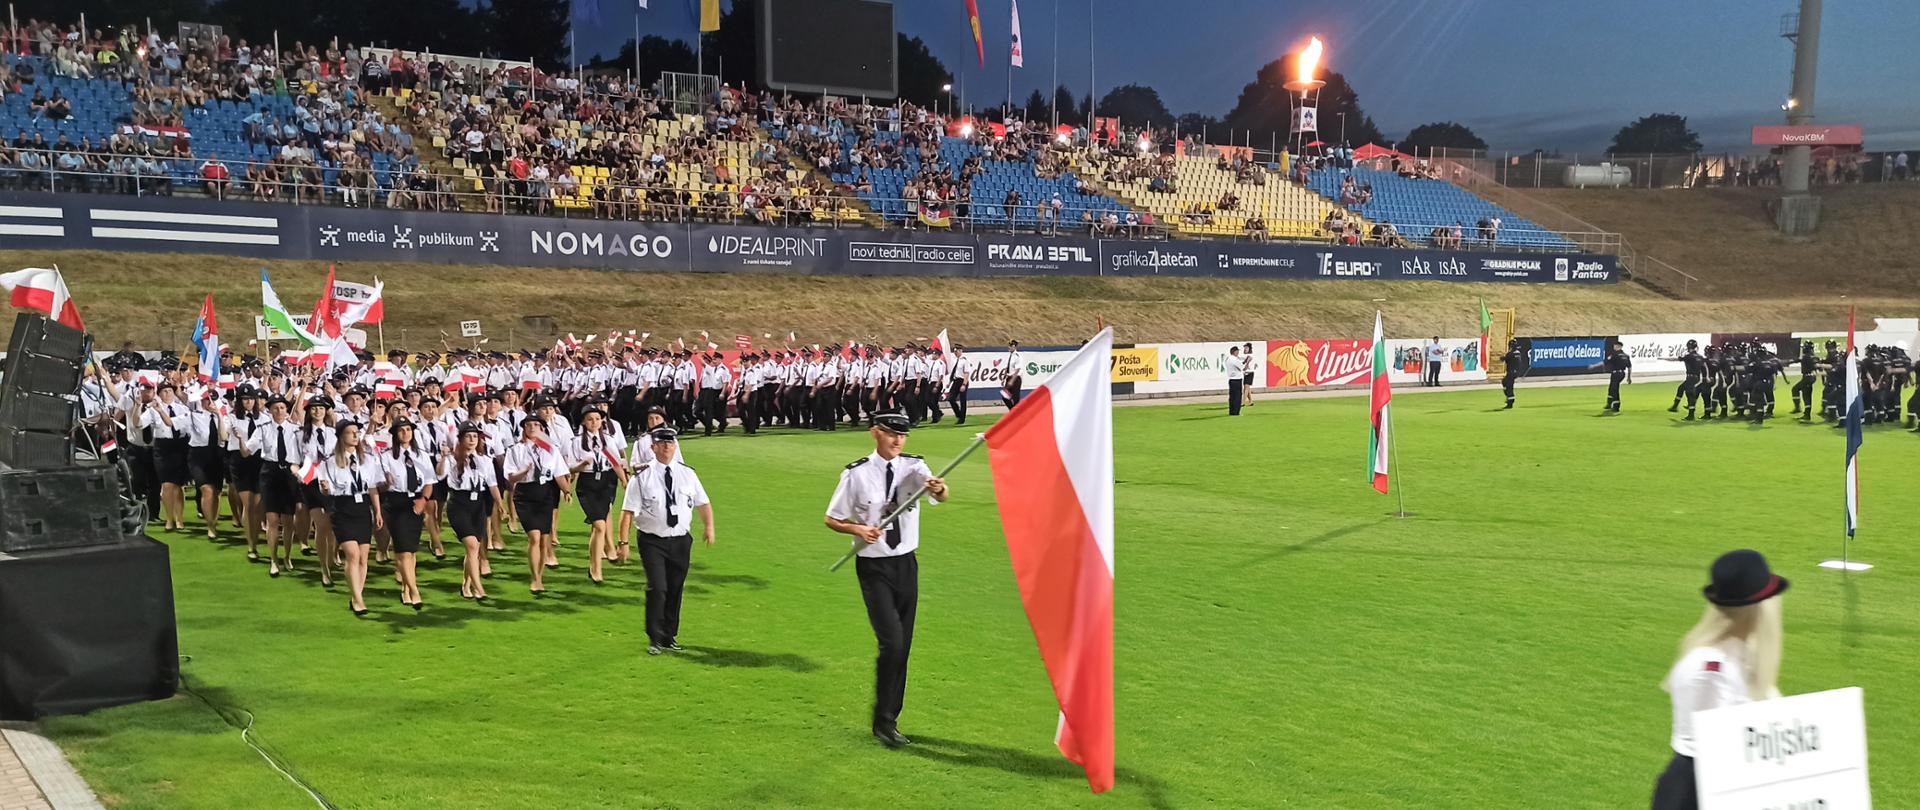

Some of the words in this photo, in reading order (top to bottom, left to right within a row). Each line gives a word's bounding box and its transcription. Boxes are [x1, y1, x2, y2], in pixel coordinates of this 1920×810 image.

[347, 230, 386, 244] media
[419, 233, 474, 247] publikum
[531, 230, 672, 258] NOMAGO
[720, 235, 827, 257] IDEALPRINT
[852, 246, 876, 258] novi
[879, 247, 911, 259] tednik
[988, 244, 1043, 260] PRANA
[918, 248, 945, 260] radio
[947, 249, 971, 261] celje
[1401, 255, 1432, 275] ISAR
[1439, 256, 1467, 276] ISAR
[1576, 261, 1604, 271] Radio
[1571, 270, 1609, 281] Fantasy
[1119, 354, 1141, 364] Pošta
[1182, 356, 1211, 371] KRKA
[1119, 365, 1154, 377] Slovenije
[1743, 718, 1821, 765] Poljska
